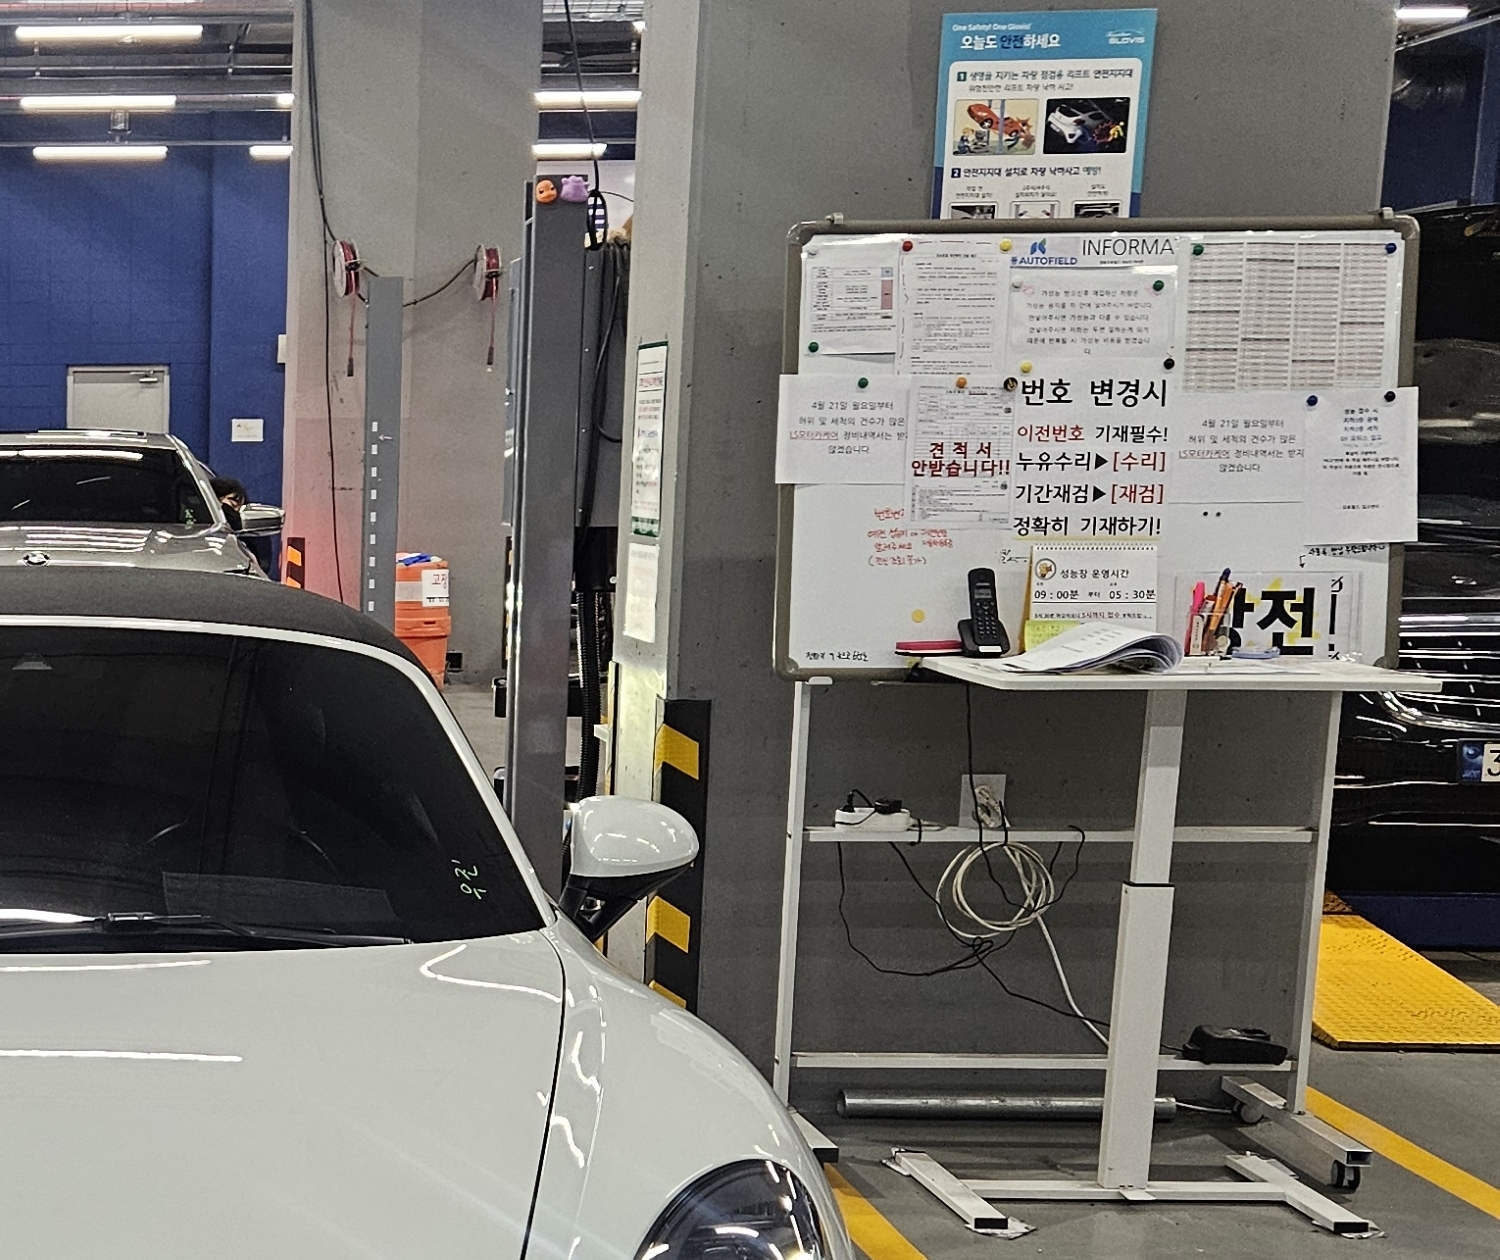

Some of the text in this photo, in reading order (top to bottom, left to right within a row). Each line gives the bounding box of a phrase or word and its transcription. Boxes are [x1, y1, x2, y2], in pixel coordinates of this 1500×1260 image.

[961, 34, 1061, 49] 오늘도 안전하세요
[1083, 238, 1177, 255] INFORMA
[1022, 378, 1073, 406] 번호
[1091, 378, 1166, 407] 변경시
[811, 401, 894, 410] 4월 21일 월요일부터
[1202, 419, 1284, 428] 4월 21일 월요일부터
[1018, 425, 1168, 443] 이전번호 기재필수!
[930, 443, 992, 459] 견 적 서
[912, 460, 1010, 477] 안받습니다!!
[1016, 452, 1166, 471] 누유수리 [수리]
[1016, 484, 1088, 503] 기간재검
[1111, 484, 1163, 504] [재검]
[1013, 516, 1160, 536] 정확히 기재하기!
[1060, 569, 1129, 578] 성능장 운영시간
[1034, 590, 1047, 599] 09
[1057, 590, 1079, 599] 00분
[1109, 590, 1121, 599] 05
[1133, 590, 1155, 599] 30분
[1487, 750, 1500, 776] 3
